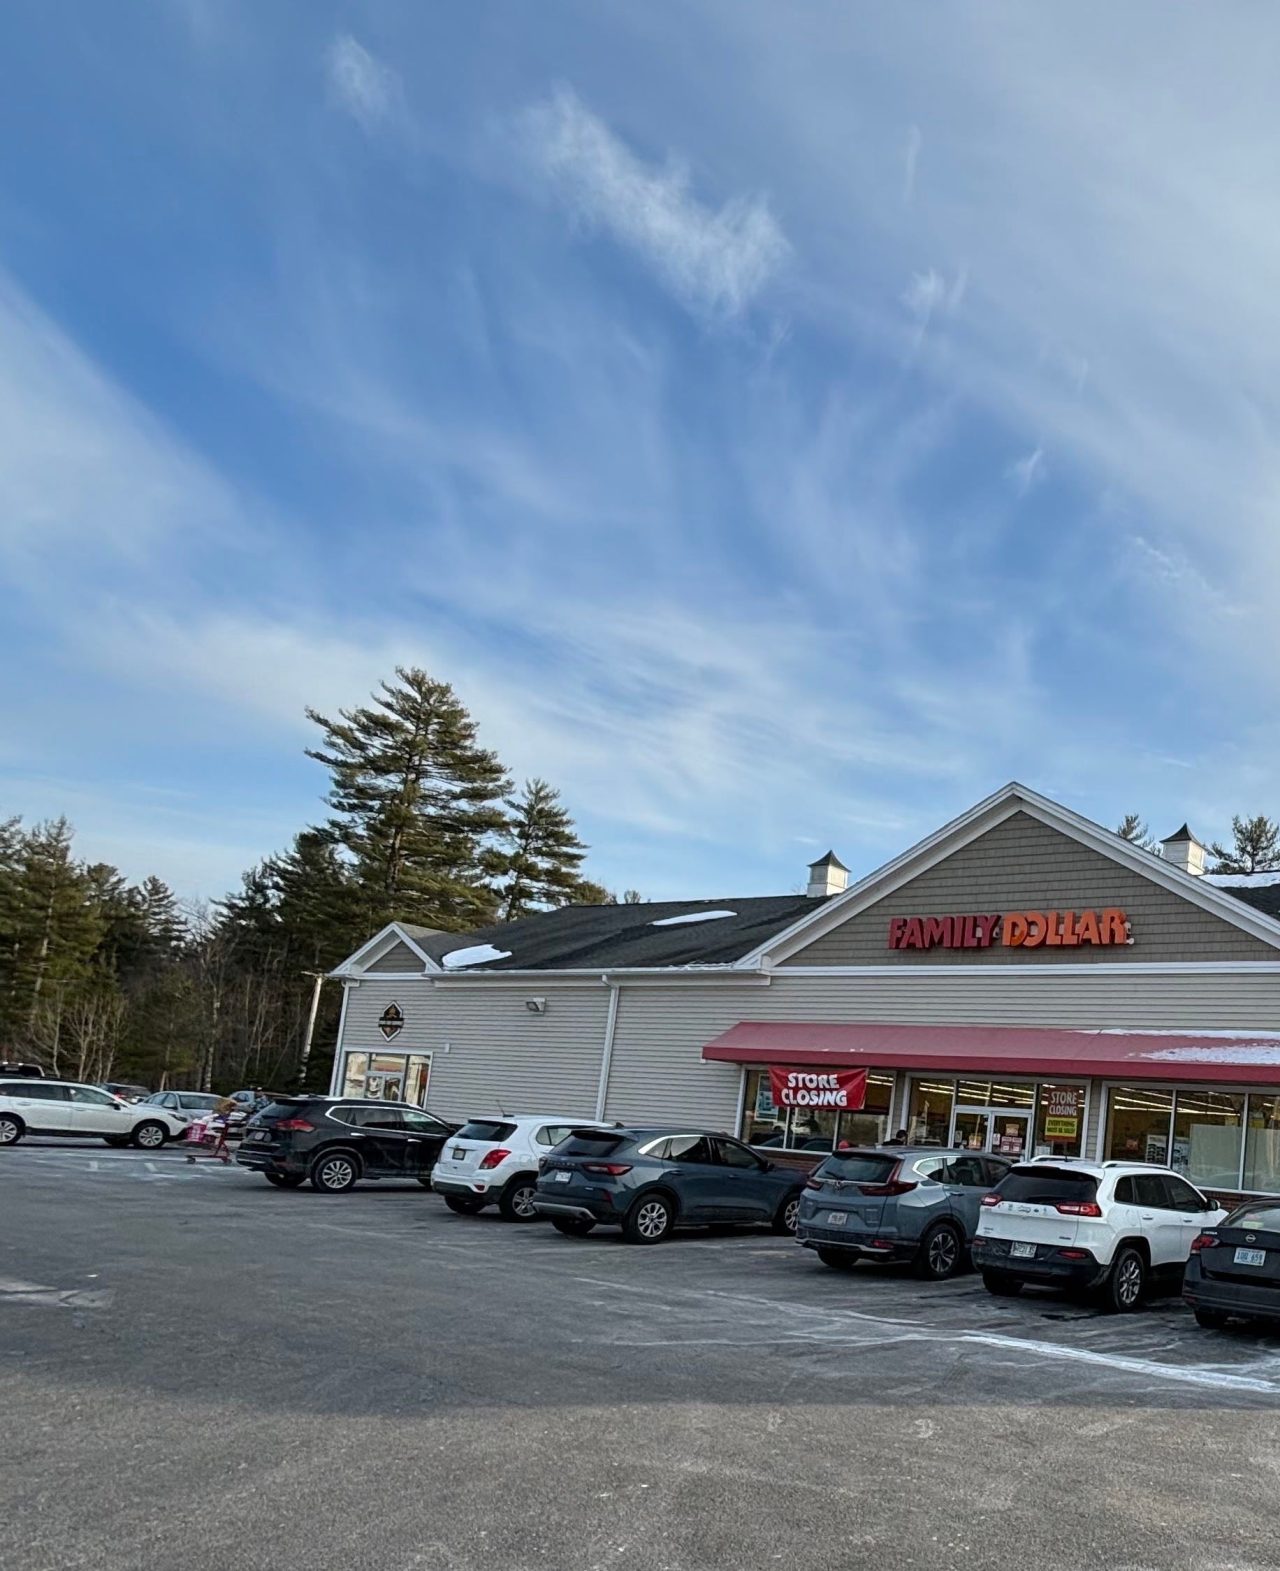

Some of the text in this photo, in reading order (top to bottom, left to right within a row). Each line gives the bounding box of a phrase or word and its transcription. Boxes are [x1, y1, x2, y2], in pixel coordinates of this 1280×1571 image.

[888, 907, 1129, 949] FAMILY DOLLAR
[787, 1072, 840, 1089] STORE
[781, 1088, 848, 1107] CLOSING
[1051, 1091, 1078, 1105] STORE
[1049, 1104, 1077, 1116] CLOSING
